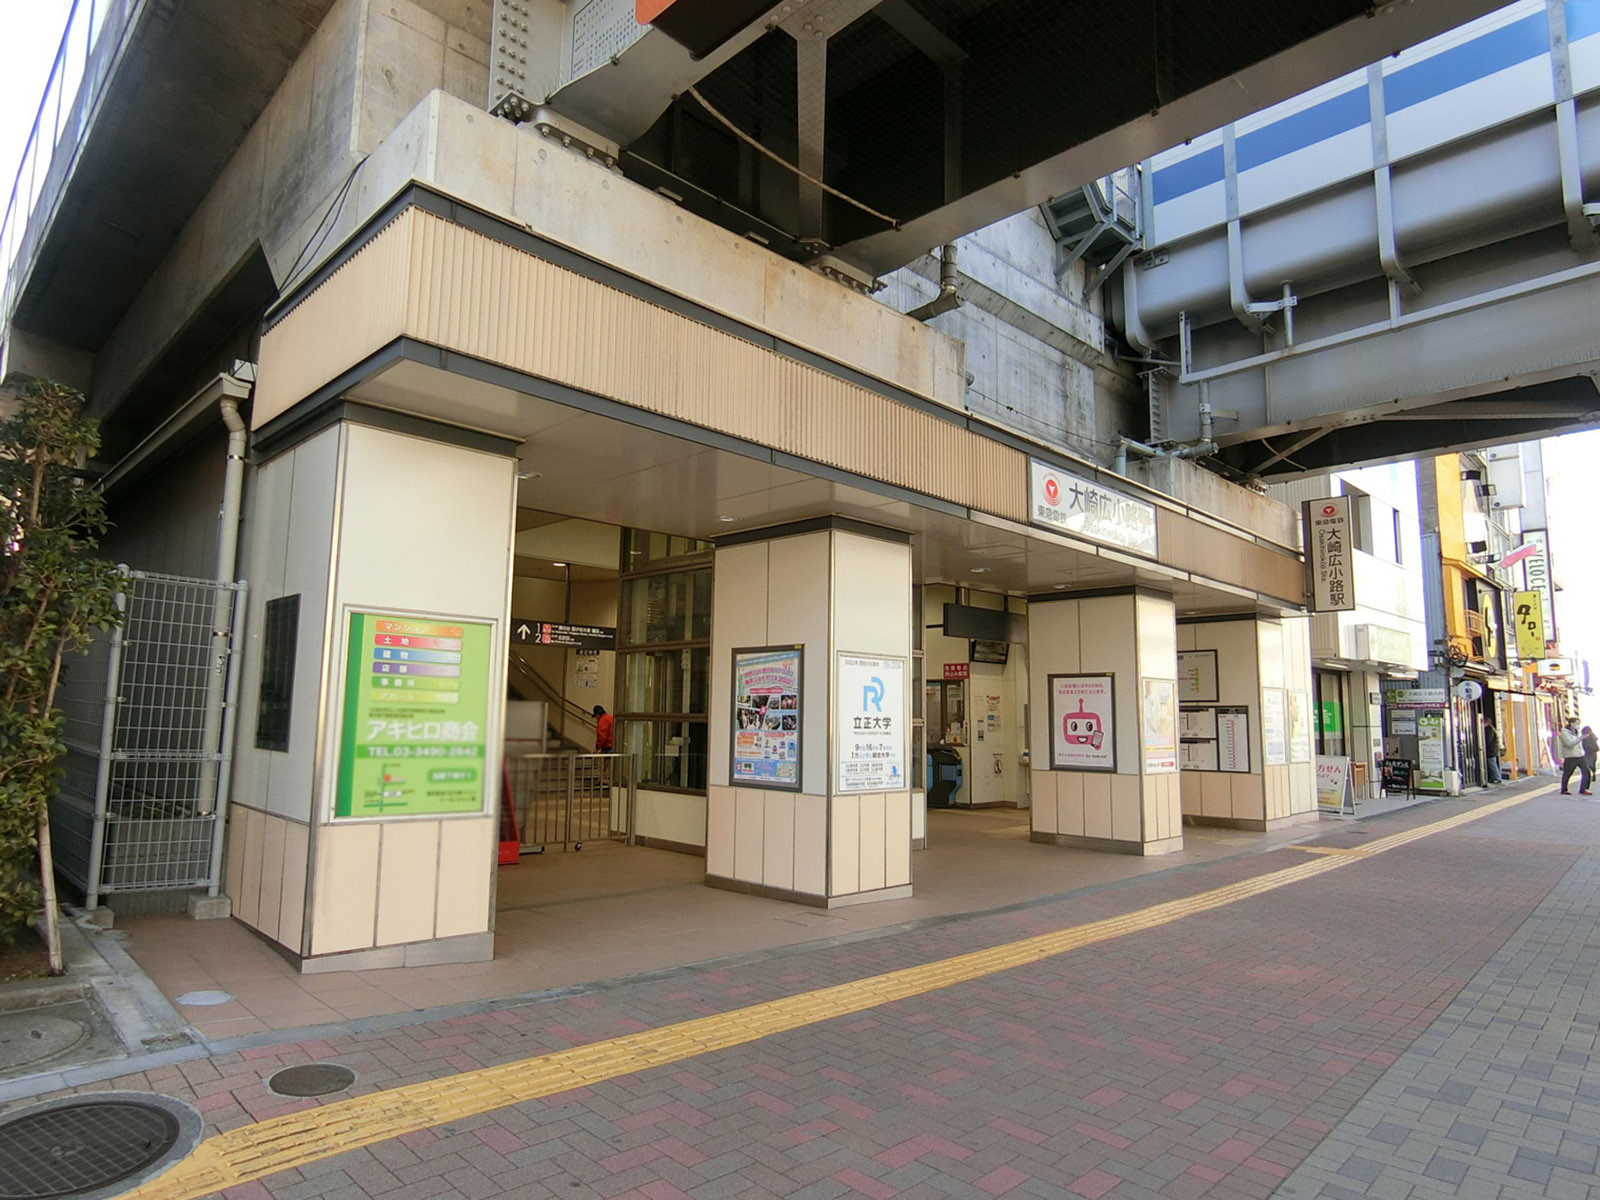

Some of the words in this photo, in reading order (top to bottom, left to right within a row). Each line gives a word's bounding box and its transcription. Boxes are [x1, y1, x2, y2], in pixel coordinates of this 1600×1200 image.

[1069, 483, 1151, 534] 大崎広小路駅
[1315, 517, 1344, 526] 東急電鉄
[1327, 528, 1345, 606] 大崎広小路駅
[384, 622, 429, 633] マンション
[535, 633, 541, 643] 2
[367, 720, 478, 740] アキヒロ商会
[853, 716, 892, 730] 立正大学
